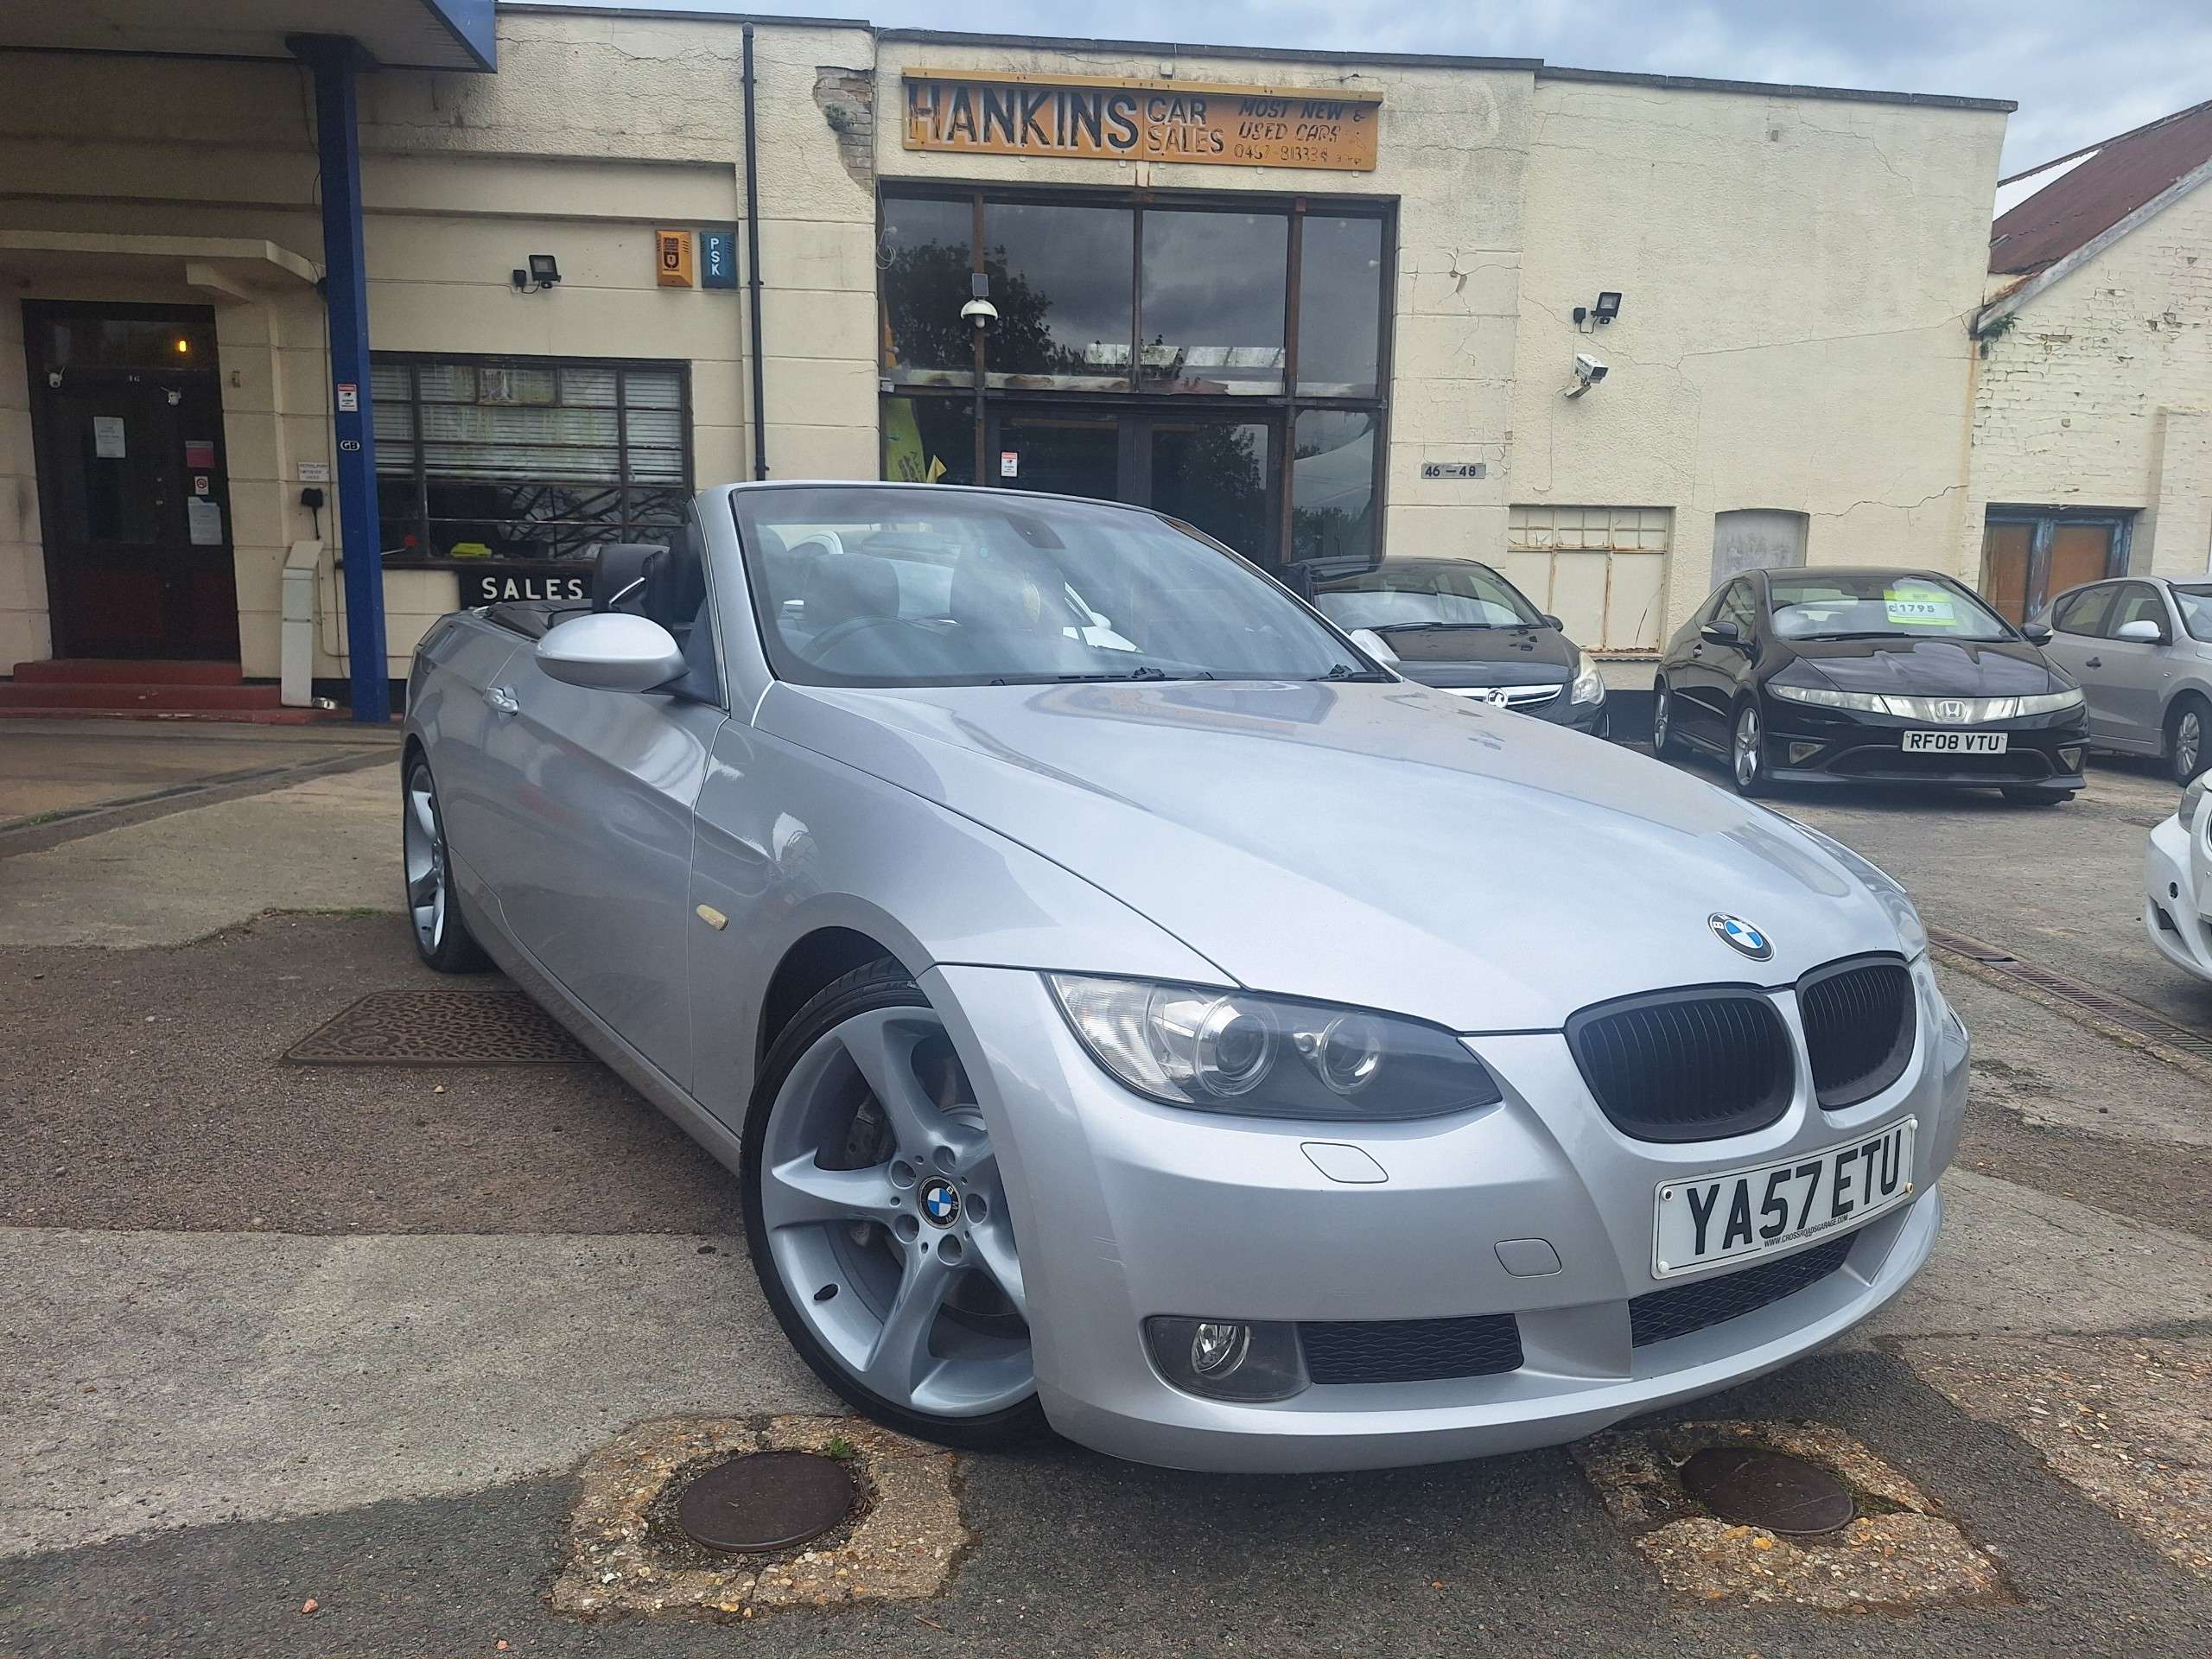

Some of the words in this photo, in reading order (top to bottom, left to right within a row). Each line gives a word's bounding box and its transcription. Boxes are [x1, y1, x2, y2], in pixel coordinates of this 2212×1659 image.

[908, 84, 1140, 149] HANKINS
[1147, 96, 1206, 124] CAR
[1238, 98, 1292, 118] MOST
[1300, 101, 1344, 121] NEW
[1147, 124, 1224, 154] SALES
[1238, 120, 1288, 140] USED
[1296, 124, 1341, 143] CARS
[710, 238, 721, 276] PSK
[341, 441, 359, 450] GB
[481, 576, 583, 601] SALES
[1888, 604, 1936, 613] £1795
[1910, 734, 1959, 750] RF08
[1966, 734, 2000, 751] VTU
[1686, 1160, 1823, 1256] YA57
[1831, 1128, 1902, 1219] ETU
[1763, 1214, 1849, 1248] WWW.CROSSROADSGARAGE.COM
